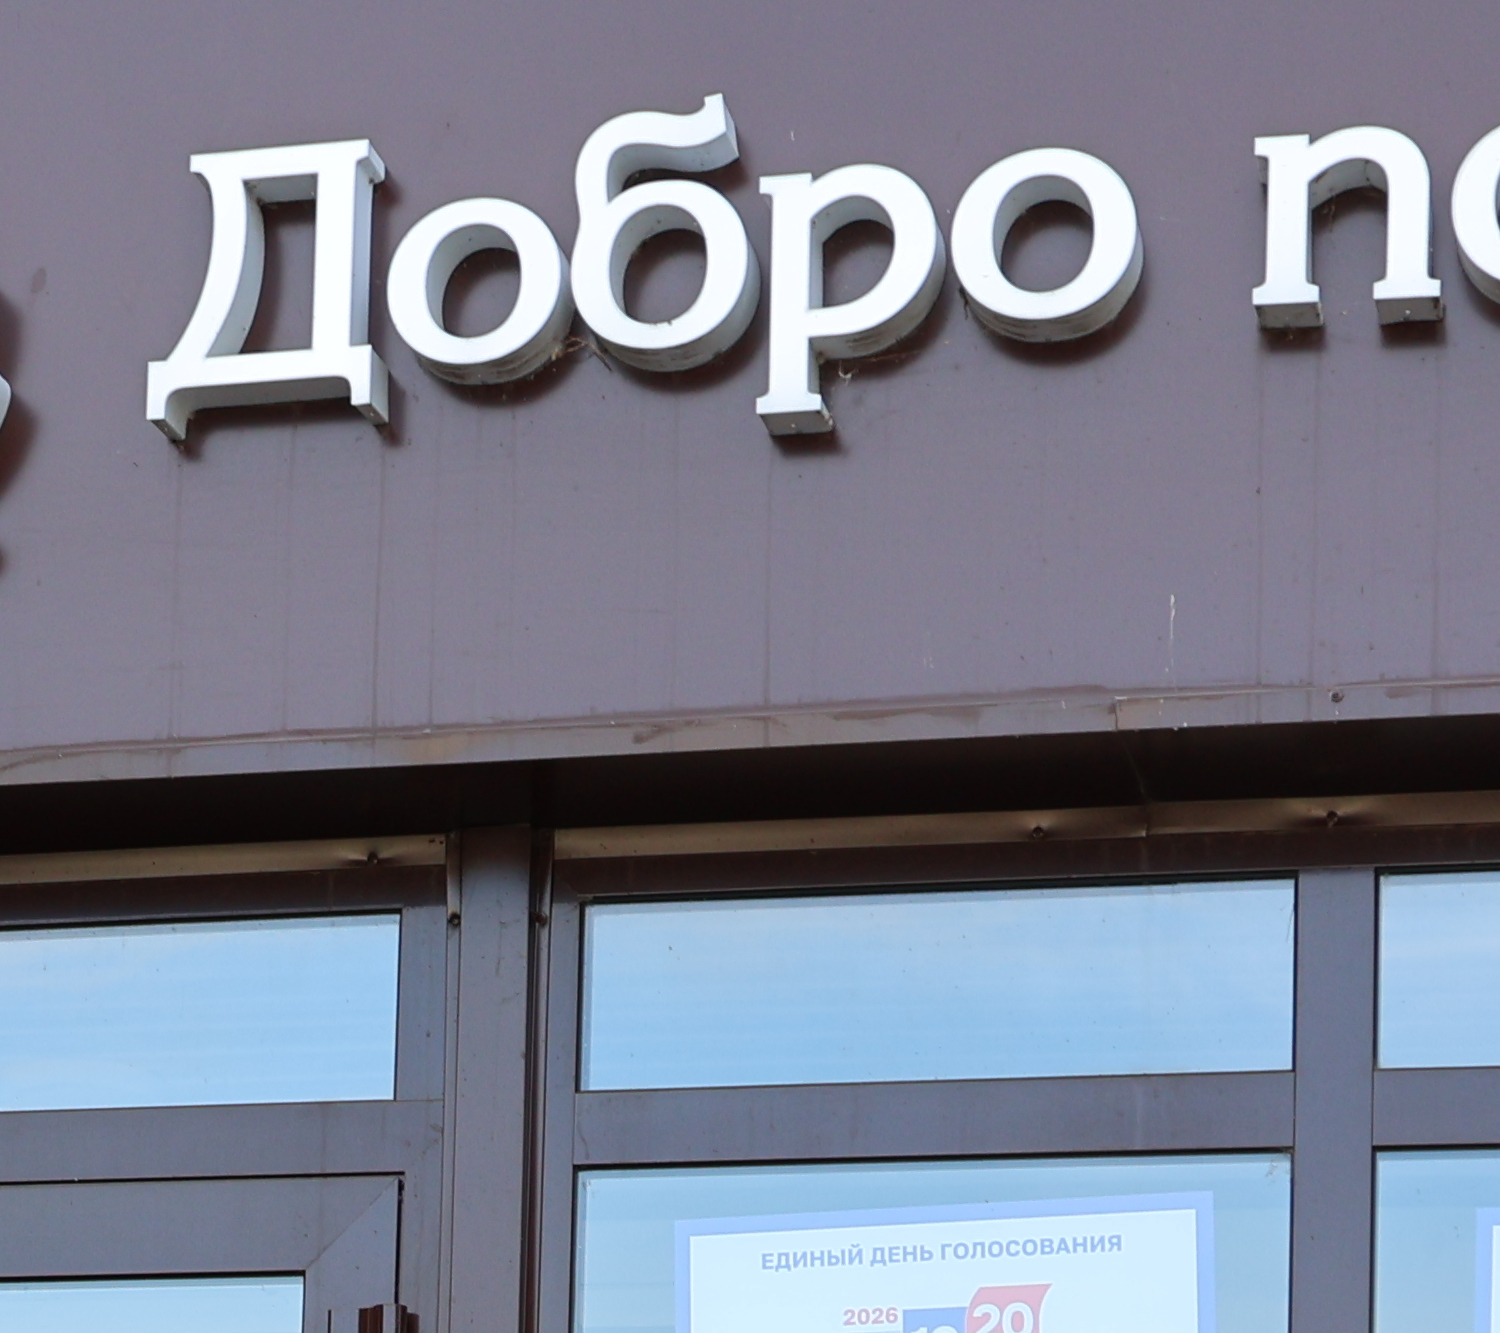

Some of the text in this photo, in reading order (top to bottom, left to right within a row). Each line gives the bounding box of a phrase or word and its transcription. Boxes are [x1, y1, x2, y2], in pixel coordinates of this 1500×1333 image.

[146, 94, 1143, 438] Добро
[761, 1234, 1123, 1272] ЕДИНЫЙ ДЕНЬ ГОЛОСОВАНИЯ
[843, 1307, 898, 1326] 2026
